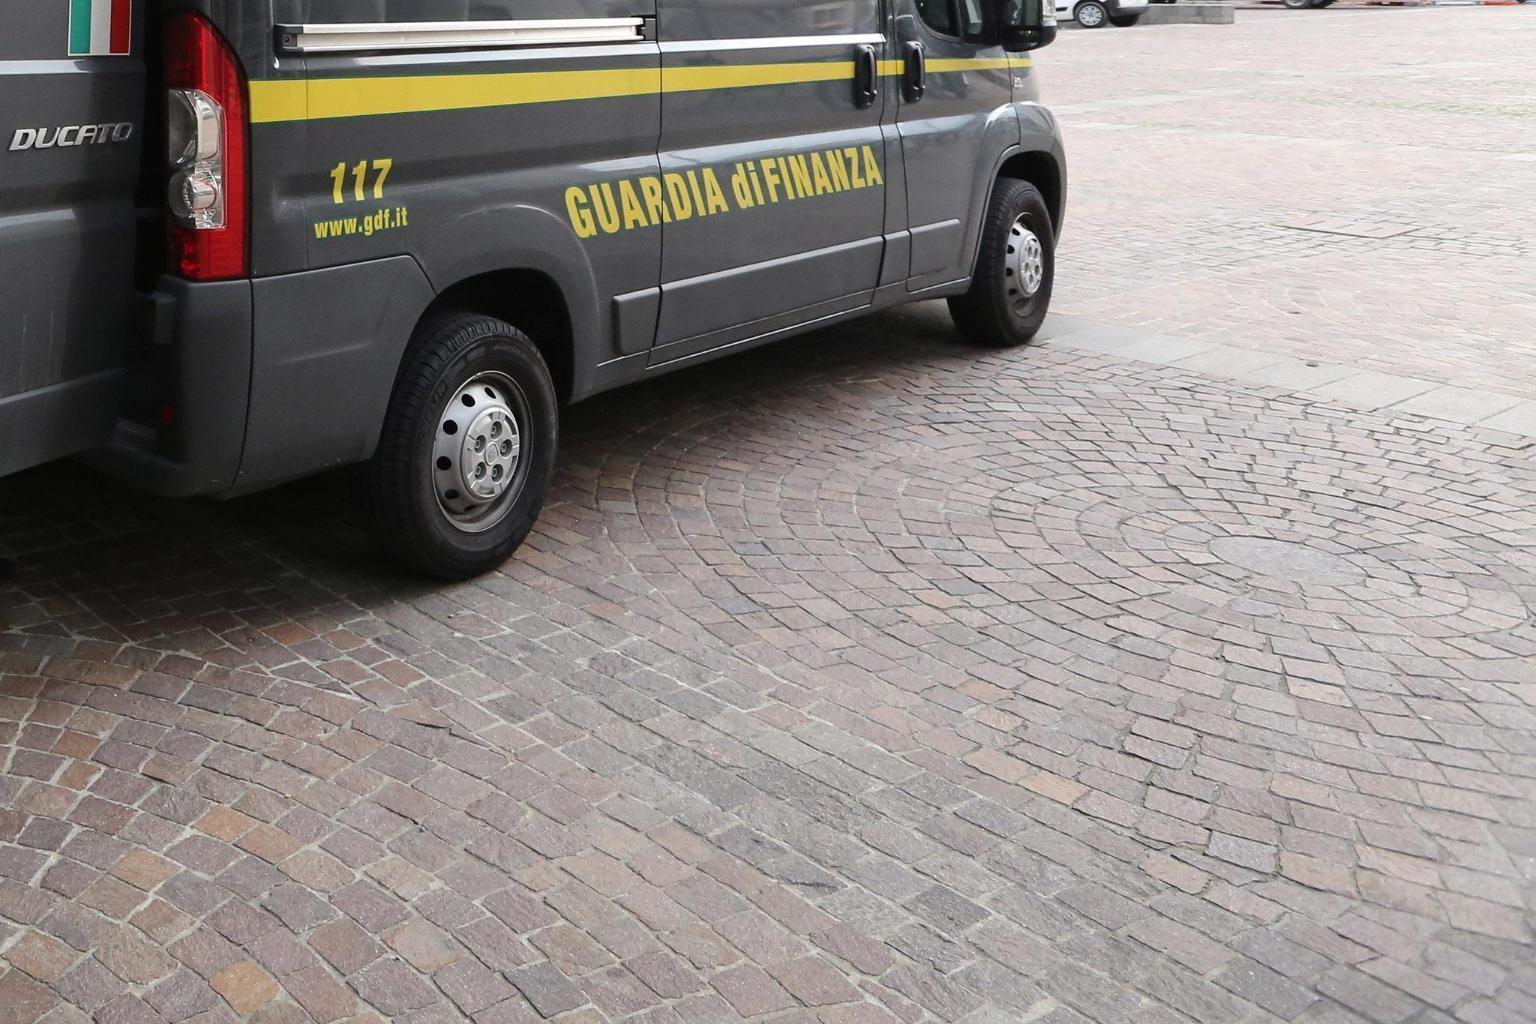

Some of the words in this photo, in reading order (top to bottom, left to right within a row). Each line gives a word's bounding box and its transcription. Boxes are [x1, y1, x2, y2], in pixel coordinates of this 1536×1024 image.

[9, 122, 134, 152] DUCATO
[330, 158, 393, 204] 117
[314, 206, 408, 239] www.gdf.it
[565, 167, 729, 239] GUARDIA
